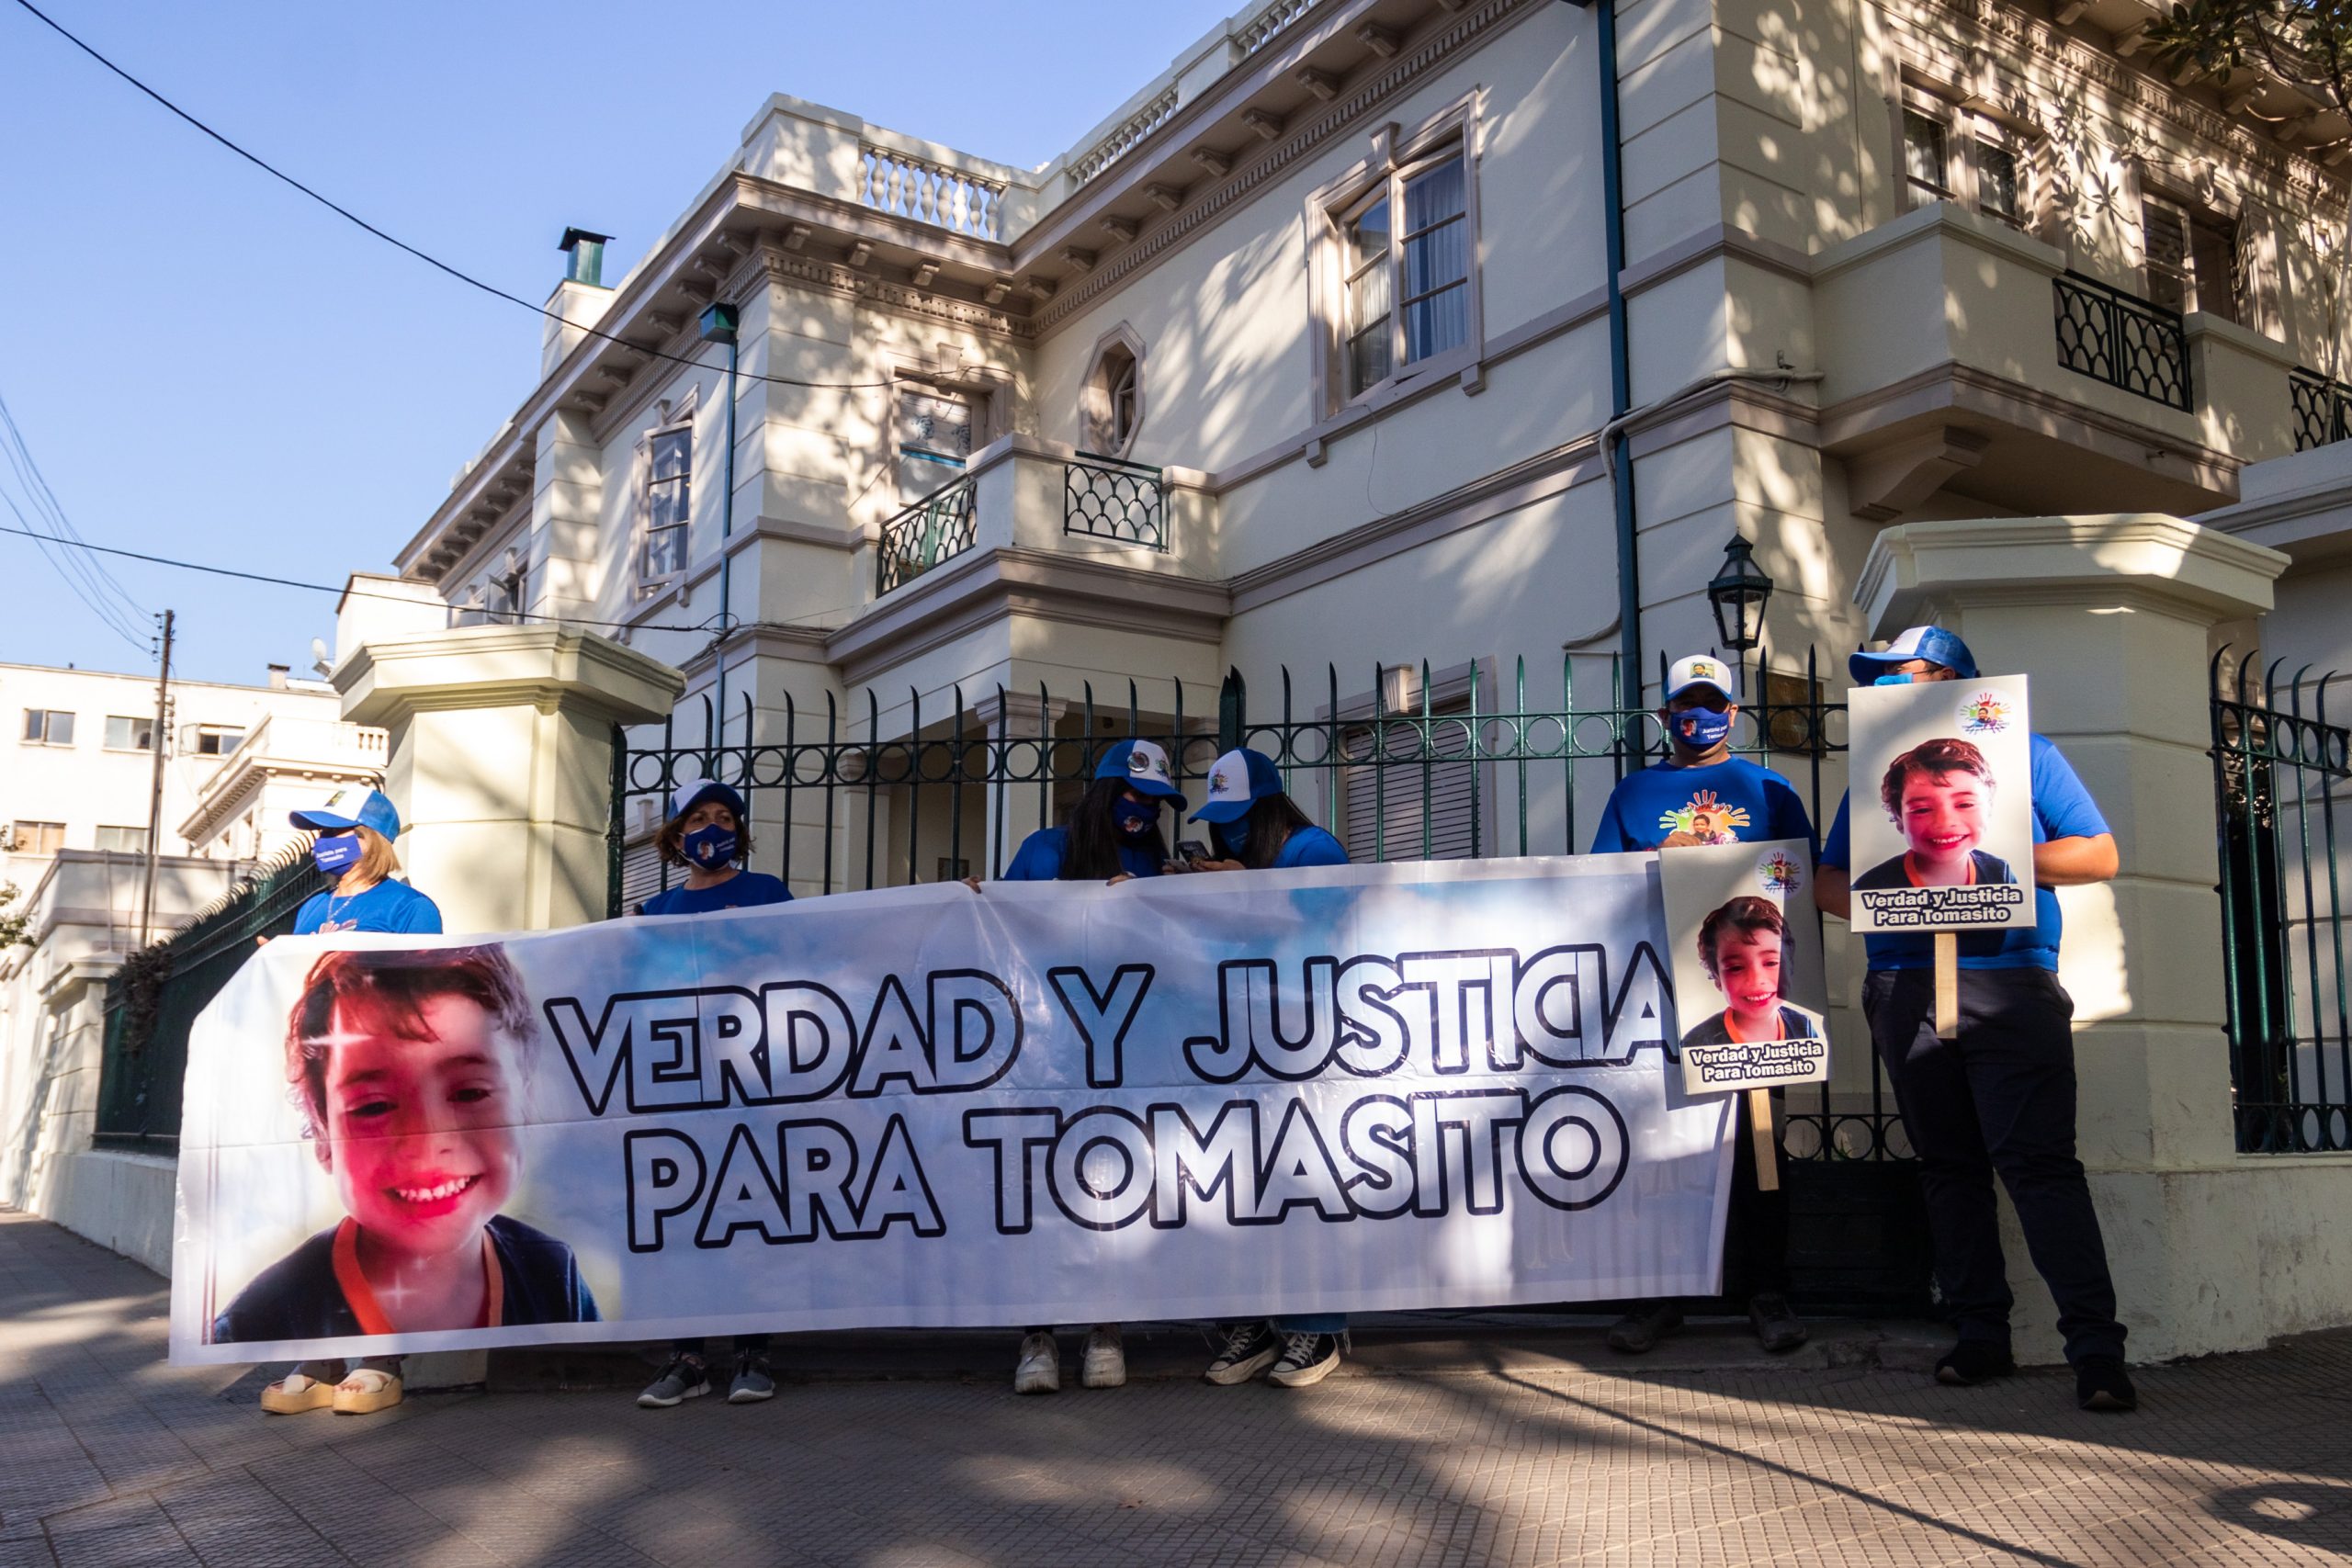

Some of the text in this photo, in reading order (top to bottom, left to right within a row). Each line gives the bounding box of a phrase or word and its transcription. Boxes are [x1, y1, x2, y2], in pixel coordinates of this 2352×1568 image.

[1861, 886, 2023, 909] Verdad y Justicia
[1874, 906, 2011, 927] Para Tomasito
[543, 941, 1680, 1116] VERDAD Y JUSTICIA
[1689, 1041, 1824, 1066] Verdad y Justicia
[1702, 1059, 1815, 1082] Para Tomasito
[624, 1085, 1630, 1253] PARA TOMASITO
